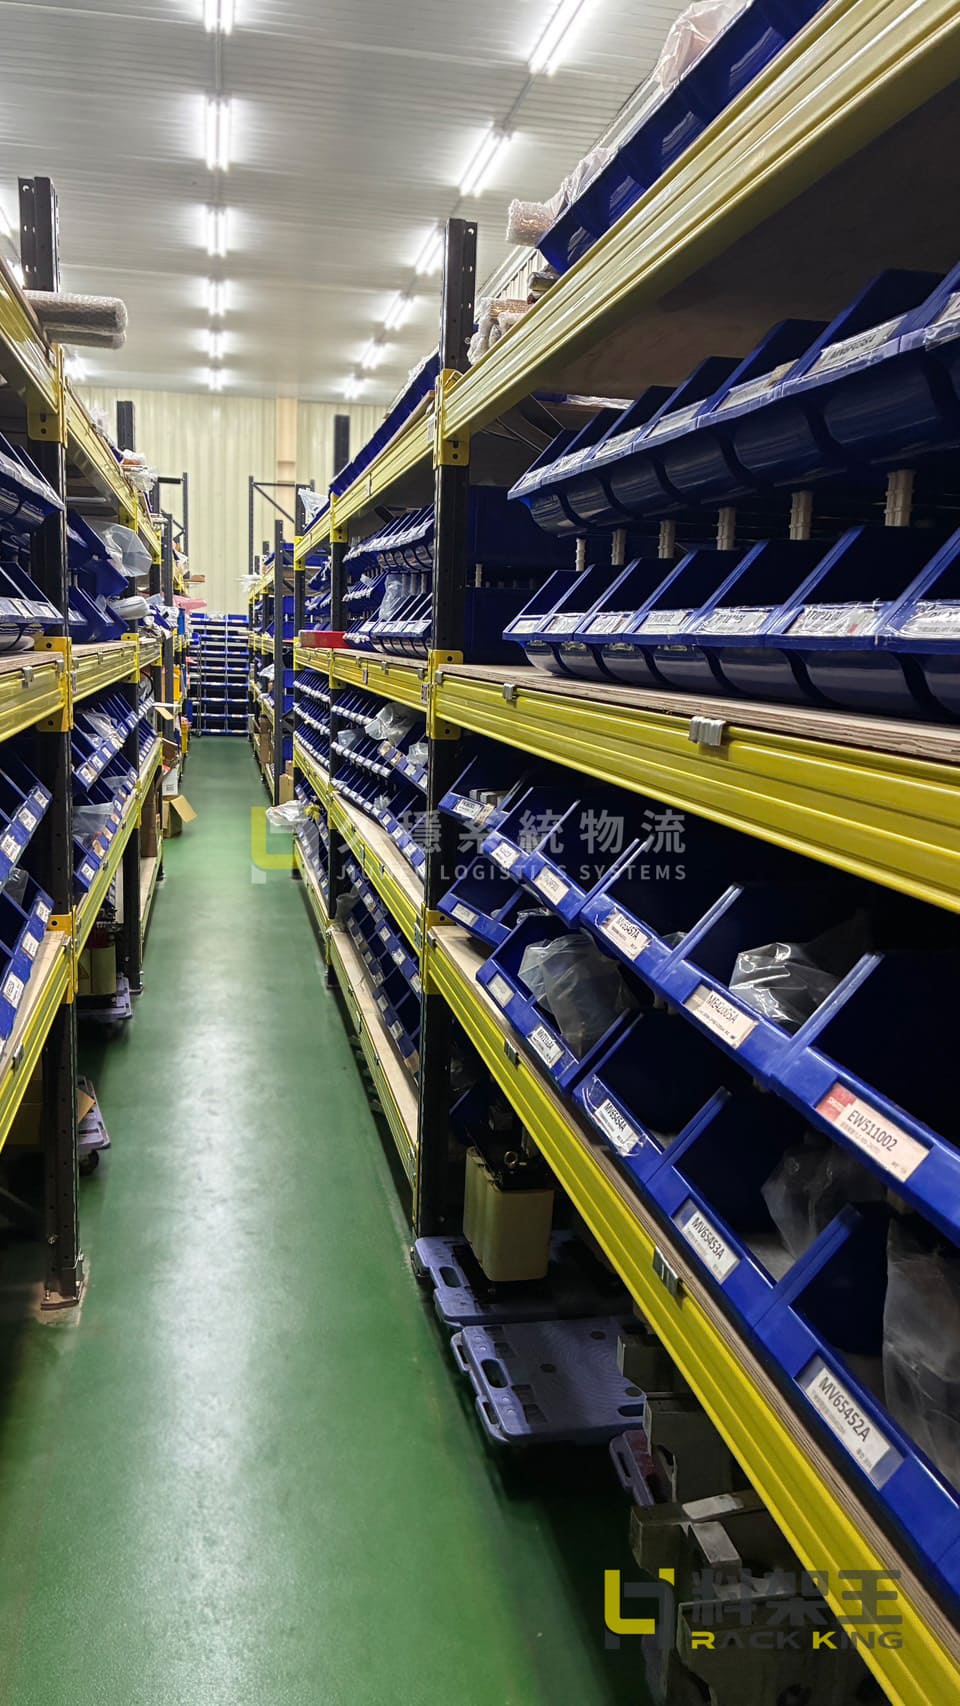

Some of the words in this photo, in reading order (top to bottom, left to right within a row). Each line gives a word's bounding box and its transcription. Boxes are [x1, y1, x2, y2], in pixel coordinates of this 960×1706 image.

[847, 1110, 898, 1152] EW511002
[691, 1217, 725, 1260] MV65453A
[819, 1377, 871, 1442] MV65452A
